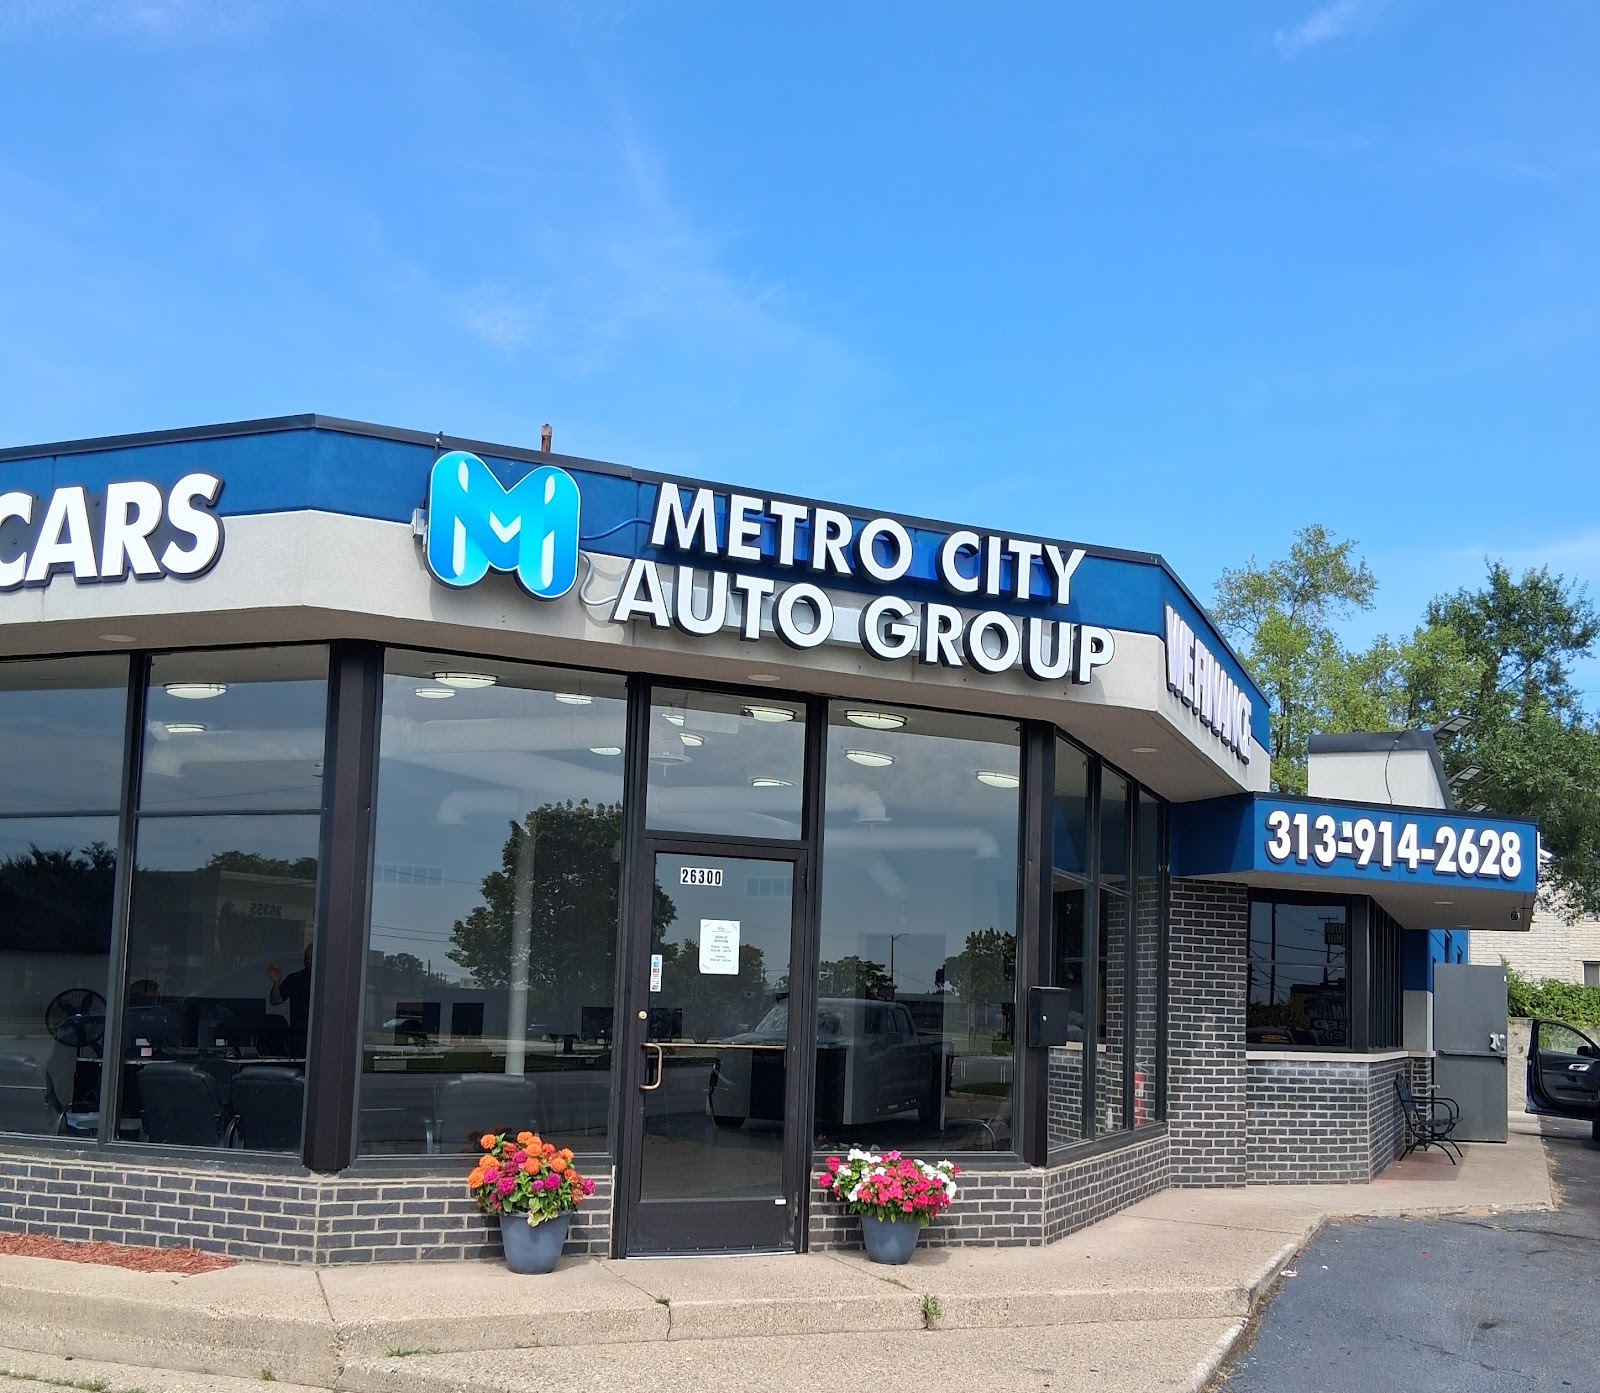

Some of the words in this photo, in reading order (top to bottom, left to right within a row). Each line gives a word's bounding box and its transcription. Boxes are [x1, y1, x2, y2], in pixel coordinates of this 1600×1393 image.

[0, 473, 220, 587] CARS
[650, 481, 913, 581] METRO
[937, 530, 1086, 604] CITY
[611, 558, 834, 648] AUTO
[861, 595, 1115, 683] GROUP
[682, 869, 721, 885] 26300
[1267, 810, 1522, 878] 313-914-2628
